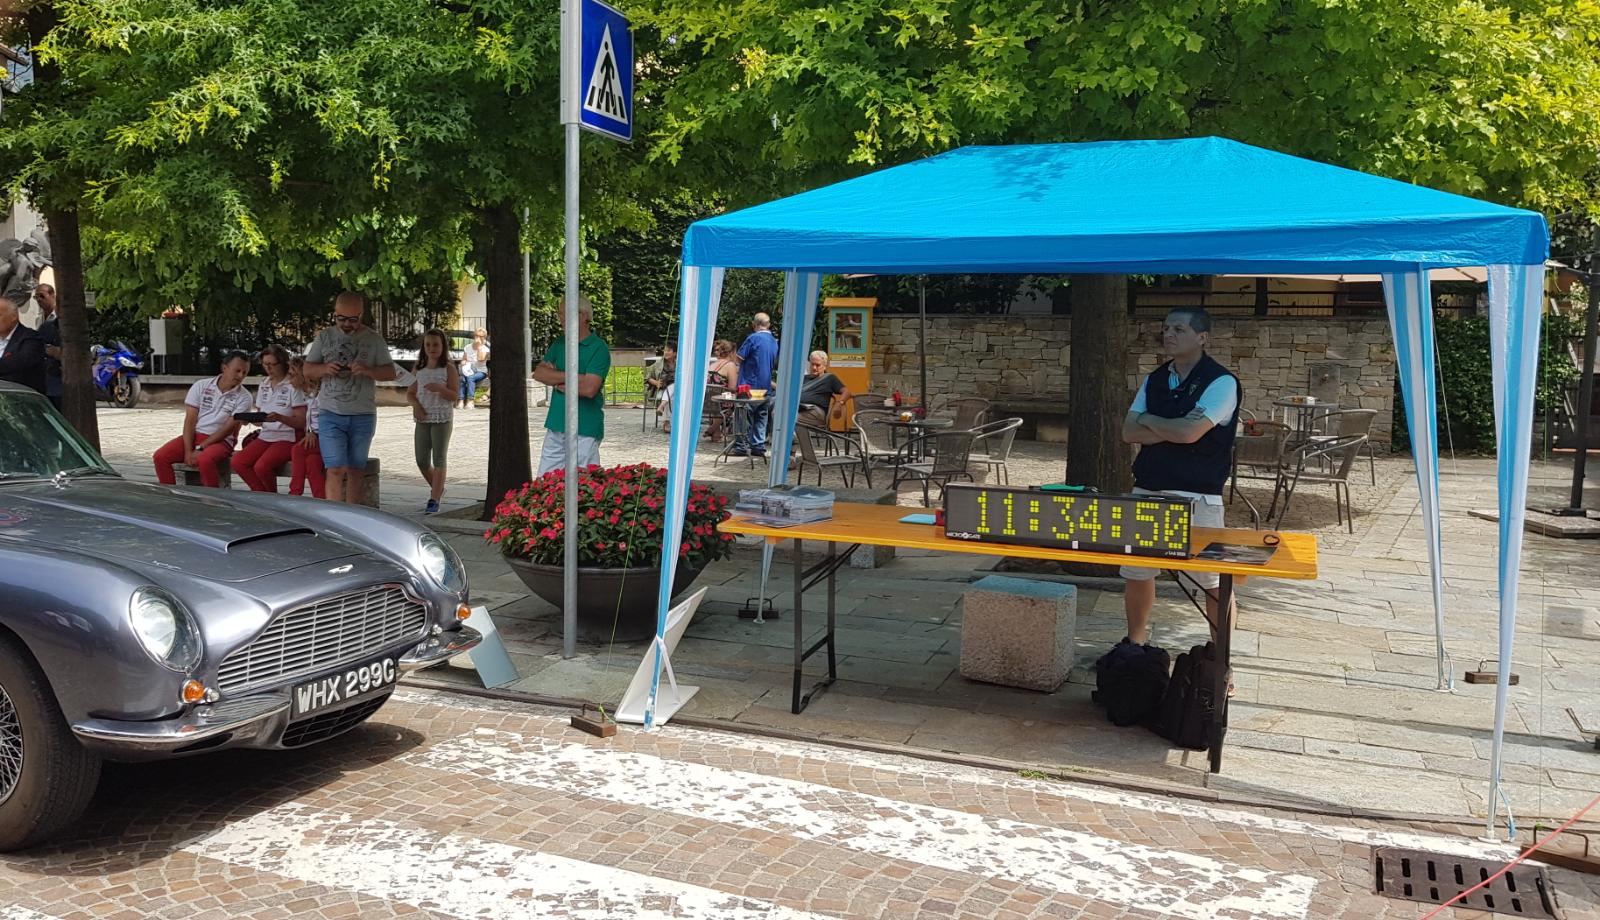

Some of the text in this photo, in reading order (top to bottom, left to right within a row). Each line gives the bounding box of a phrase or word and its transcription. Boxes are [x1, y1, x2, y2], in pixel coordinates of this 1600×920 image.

[977, 490, 1188, 549] 11:34:50
[297, 657, 395, 714] WHX 299G
